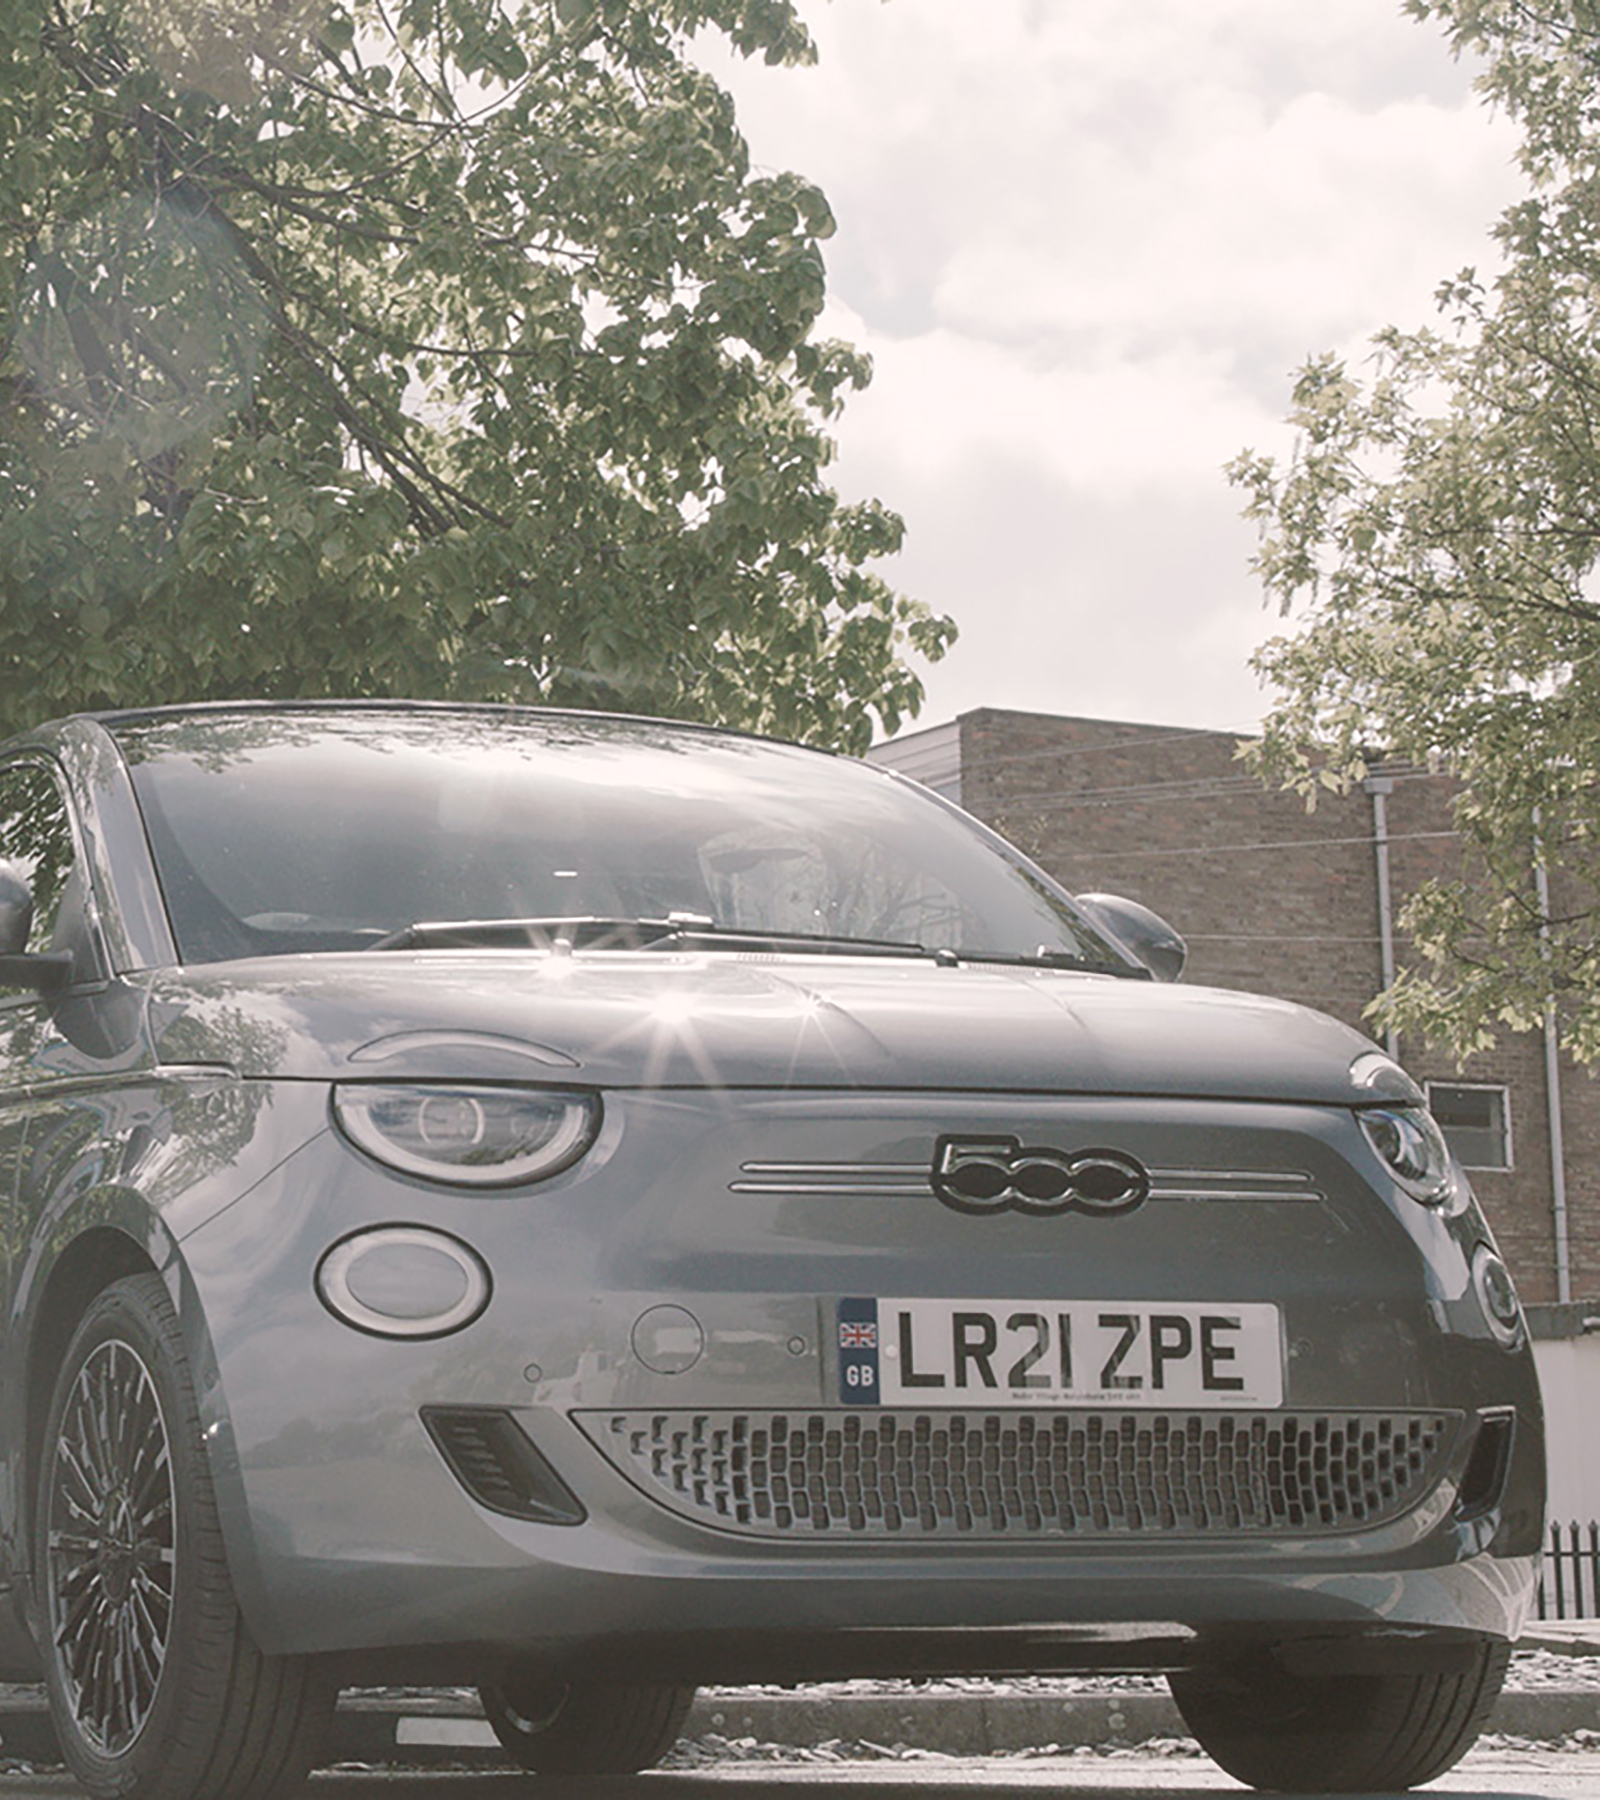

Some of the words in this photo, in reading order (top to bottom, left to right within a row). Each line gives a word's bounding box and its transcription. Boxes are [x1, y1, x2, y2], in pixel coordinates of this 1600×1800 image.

[936, 1138, 1145, 1212] 500
[846, 1364, 874, 1387] GB
[898, 1311, 1073, 1389] LR21
[1099, 1313, 1245, 1392] ZPE
